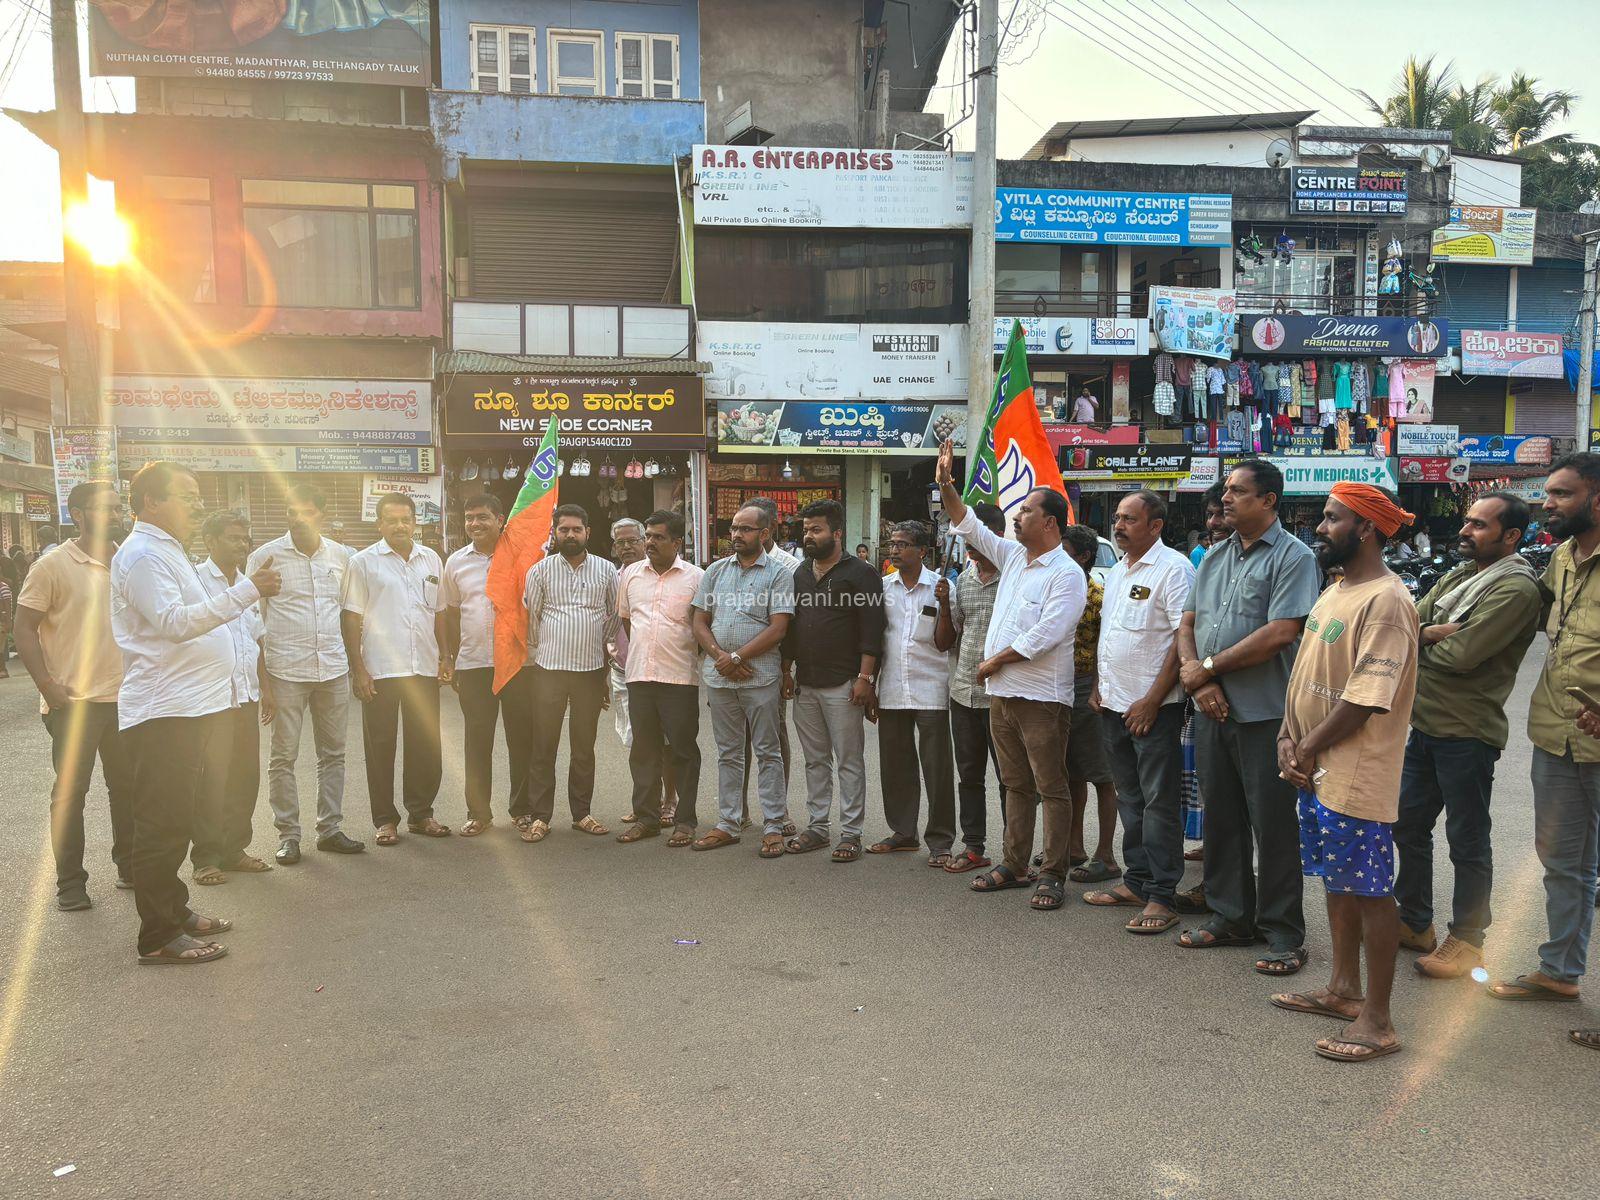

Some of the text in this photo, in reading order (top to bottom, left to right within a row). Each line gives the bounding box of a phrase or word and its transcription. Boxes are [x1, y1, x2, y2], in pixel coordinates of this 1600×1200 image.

[106, 53, 420, 74] NUTHAN CLOTH CENTRE, MADANTHYAR, BELTHANGADY TALUK
[206, 67, 234, 77] 94480
[237, 68, 266, 79] 84555
[274, 70, 303, 80] 99723
[305, 71, 334, 82] 97533
[702, 149, 893, 171] A.R. ENTERPRISES
[1298, 177, 1402, 191] CENTRE POINT
[702, 193, 730, 201] VRL
[1004, 193, 1185, 210] VITLA COMMUNITY CENTRE
[744, 216, 760, 224] Bus
[762, 216, 787, 224] Online
[790, 217, 822, 225] Booking
[1125, 209, 1178, 225] ಸೆಂಟರ್
[1023, 231, 1067, 239] COUNSELLING
[1106, 234, 1178, 242] EDUCATIONAL GUIDANCE
[1024, 328, 1047, 337] obile
[1312, 317, 1381, 340] Deena
[874, 335, 929, 343] WESTERN
[1303, 339, 1389, 348] FASHION CENTER
[733, 350, 756, 358] Booking
[797, 347, 835, 356] Online Booking
[474, 387, 675, 417] ನ್ಯೂ ಶೂ ಕಾರ್ನರ್
[500, 418, 653, 431] NEW SOE CORNER
[138, 428, 160, 437] 574
[166, 428, 190, 437] 243
[318, 430, 343, 441] Mob.
[352, 431, 417, 442] 9448887483
[1401, 432, 1456, 440] MOBILE TOUCH
[1096, 456, 1186, 468] MOBILE PLANET
[1286, 468, 1369, 482] CITY MEDICALS
[377, 483, 415, 493] IDEAL
